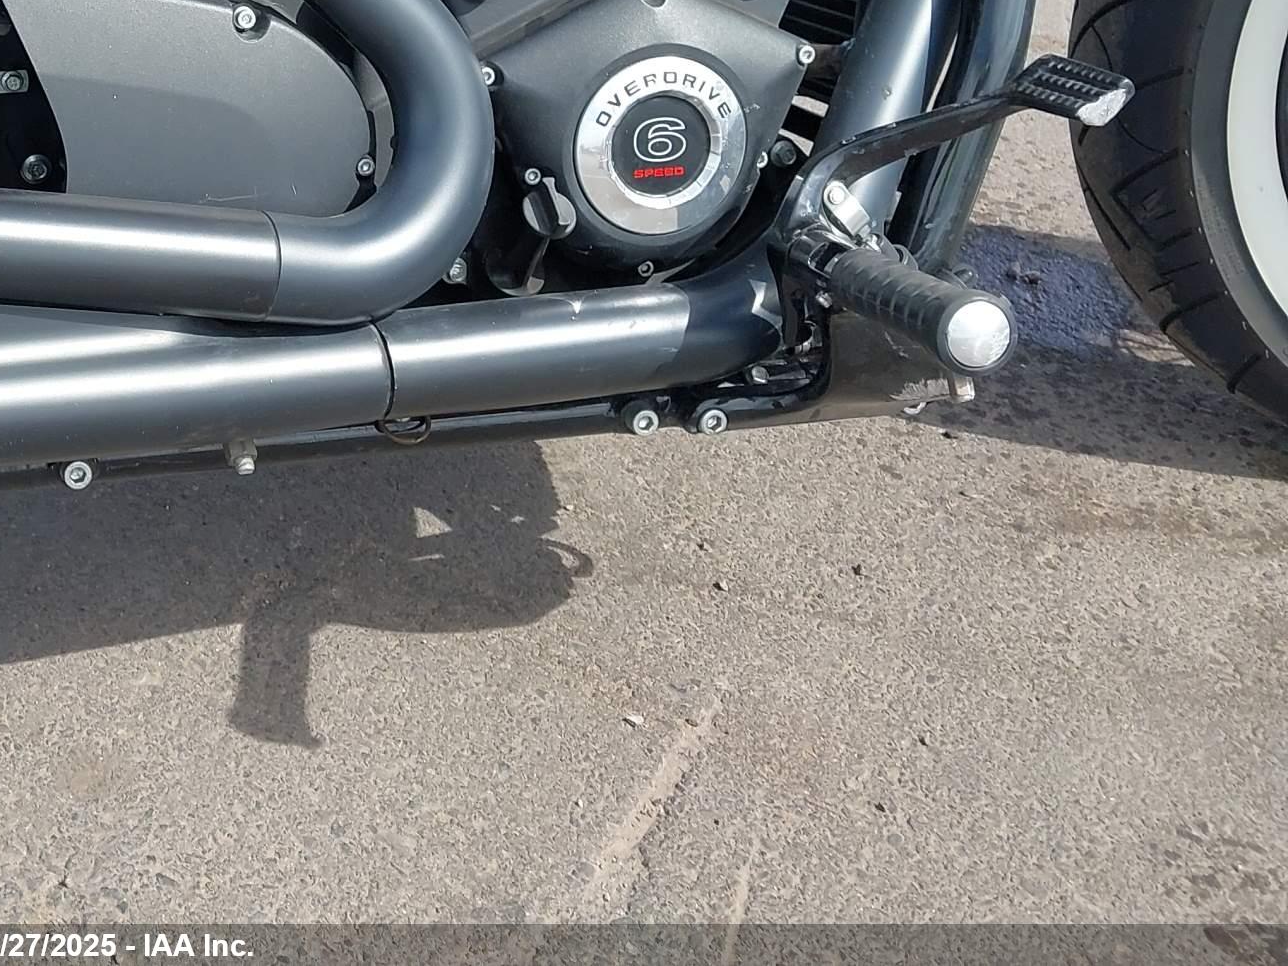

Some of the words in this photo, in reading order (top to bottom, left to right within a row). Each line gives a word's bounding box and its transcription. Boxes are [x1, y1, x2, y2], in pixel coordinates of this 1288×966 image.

[596, 71, 732, 127] OVERDRIVE
[633, 117, 687, 162] 6
[632, 166, 686, 180] SPEED
